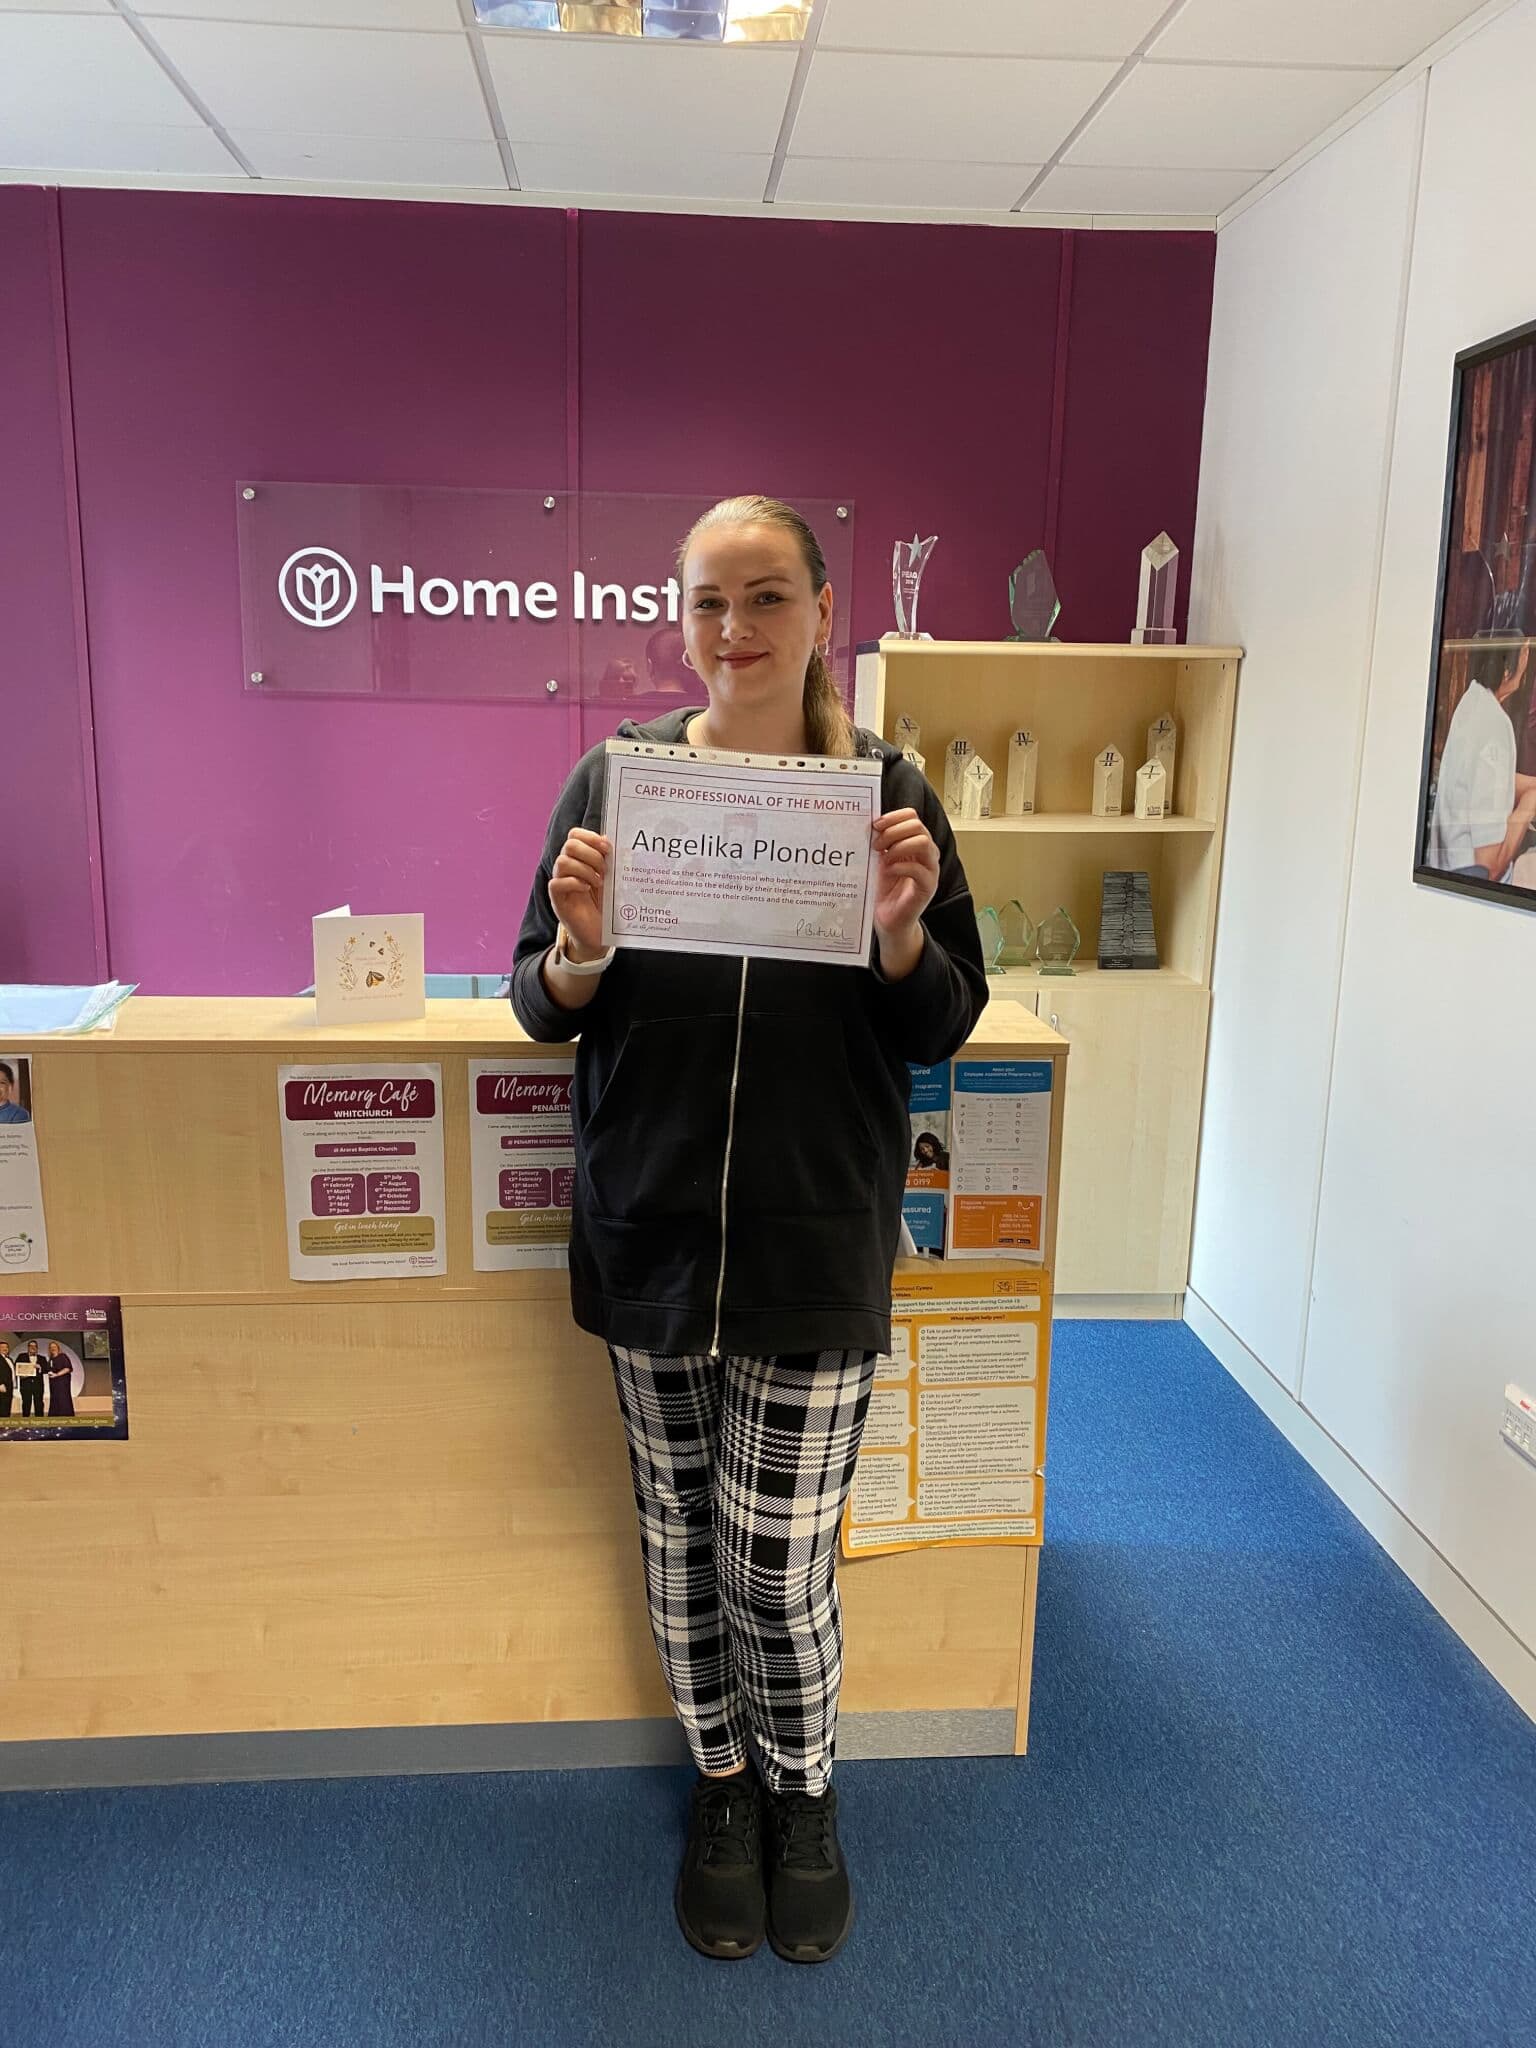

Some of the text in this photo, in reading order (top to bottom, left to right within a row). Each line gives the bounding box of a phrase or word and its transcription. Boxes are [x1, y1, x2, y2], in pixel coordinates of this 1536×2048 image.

[369, 564, 681, 624] Home Inst
[955, 741, 967, 755] III
[1104, 752, 1114, 766] II
[634, 784, 860, 812] CARE PROFESSIONAL OF THE MONTH
[632, 830, 856, 867] Angelika Plonder
[632, 866, 670, 876] recognised
[714, 872, 758, 882] Professional
[794, 878, 834, 888] exemplifies
[622, 875, 654, 884] Instead's
[656, 878, 694, 888] dedication
[718, 883, 743, 892] elderly
[744, 884, 754, 892] by
[755, 886, 772, 894] their
[804, 889, 858, 899] compassionate
[656, 888, 685, 896] devoted
[686, 890, 711, 898] service
[722, 893, 740, 901] their
[740, 894, 766, 902] clients
[640, 906, 672, 916] Home
[640, 914, 679, 925] Instead
[304, 1081, 420, 1112] Memory Café
[494, 1076, 565, 1104] Memory
[334, 1110, 392, 1118] WHITCHURCH
[532, 1104, 570, 1112] PENARTH
[334, 1222, 349, 1233] Get
[358, 1222, 377, 1231] touch
[18, 1312, 78, 1320] CONFERENCE
